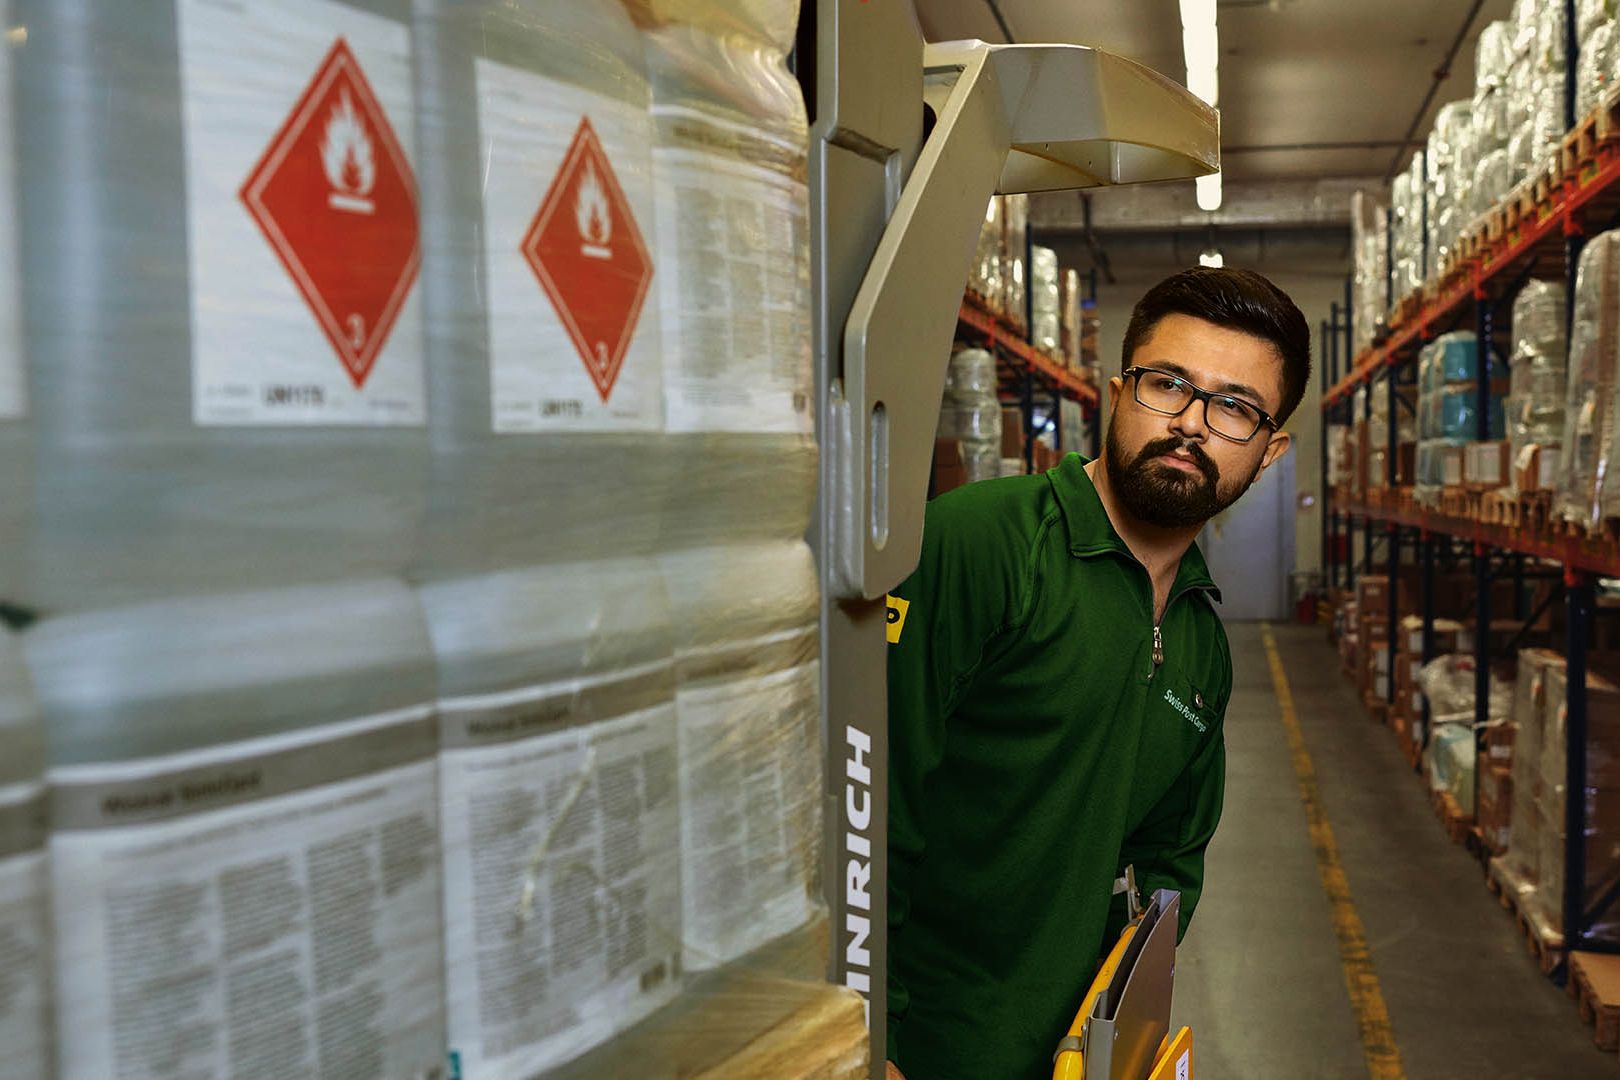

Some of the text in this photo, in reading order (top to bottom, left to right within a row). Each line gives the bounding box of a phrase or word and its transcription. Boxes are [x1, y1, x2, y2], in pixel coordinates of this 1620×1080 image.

[347, 313, 363, 348] 3
[597, 340, 608, 369] 3
[1164, 689, 1184, 712] Swiss
[1181, 705, 1195, 722] Post
[846, 725, 871, 1032] INRICH
